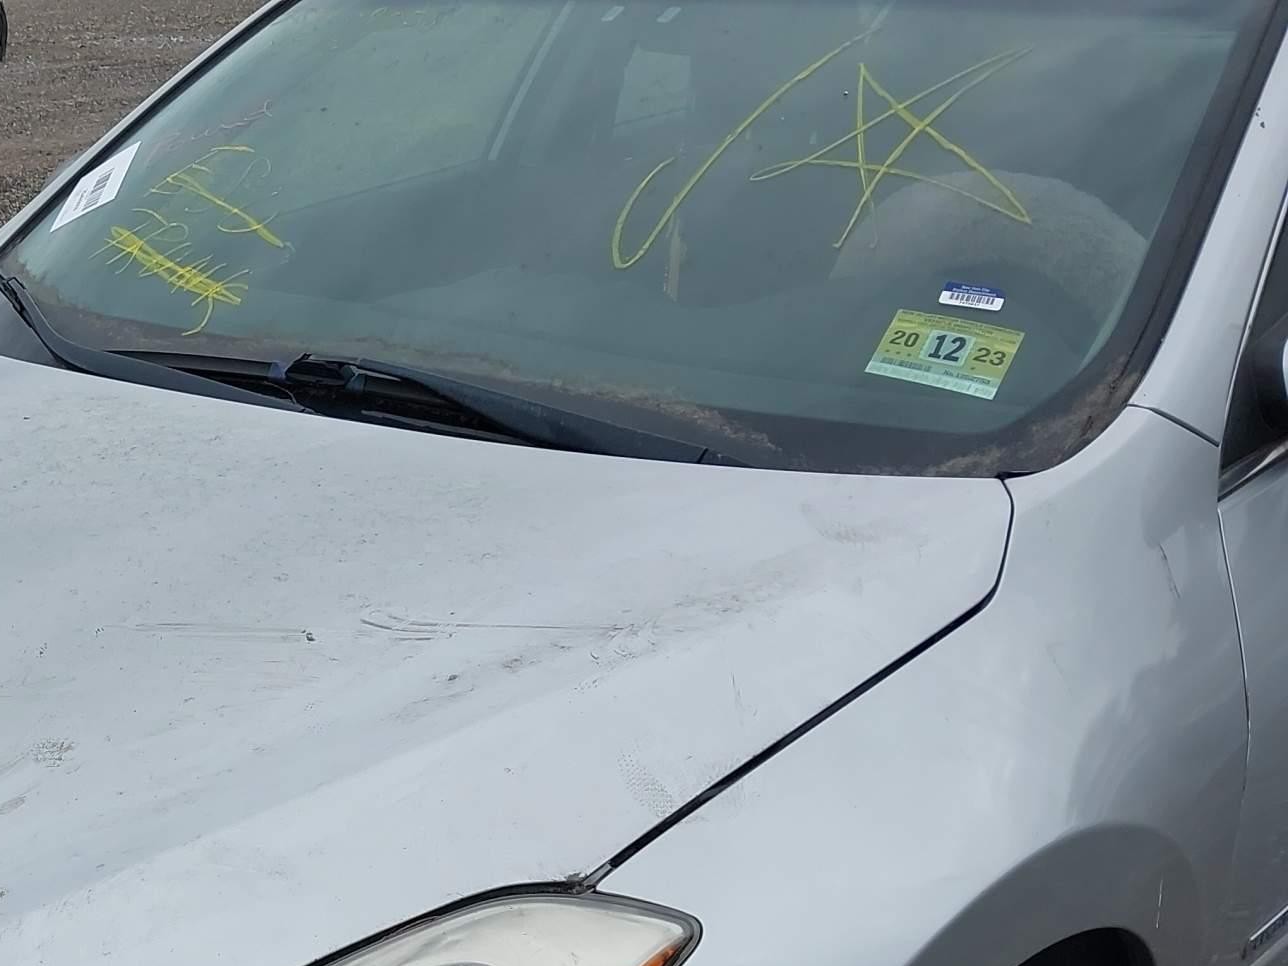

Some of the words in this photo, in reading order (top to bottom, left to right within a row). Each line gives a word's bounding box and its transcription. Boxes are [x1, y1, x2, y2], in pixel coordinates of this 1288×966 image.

[889, 330, 920, 348] 20
[927, 333, 967, 362] 12
[972, 347, 1007, 366] 23
